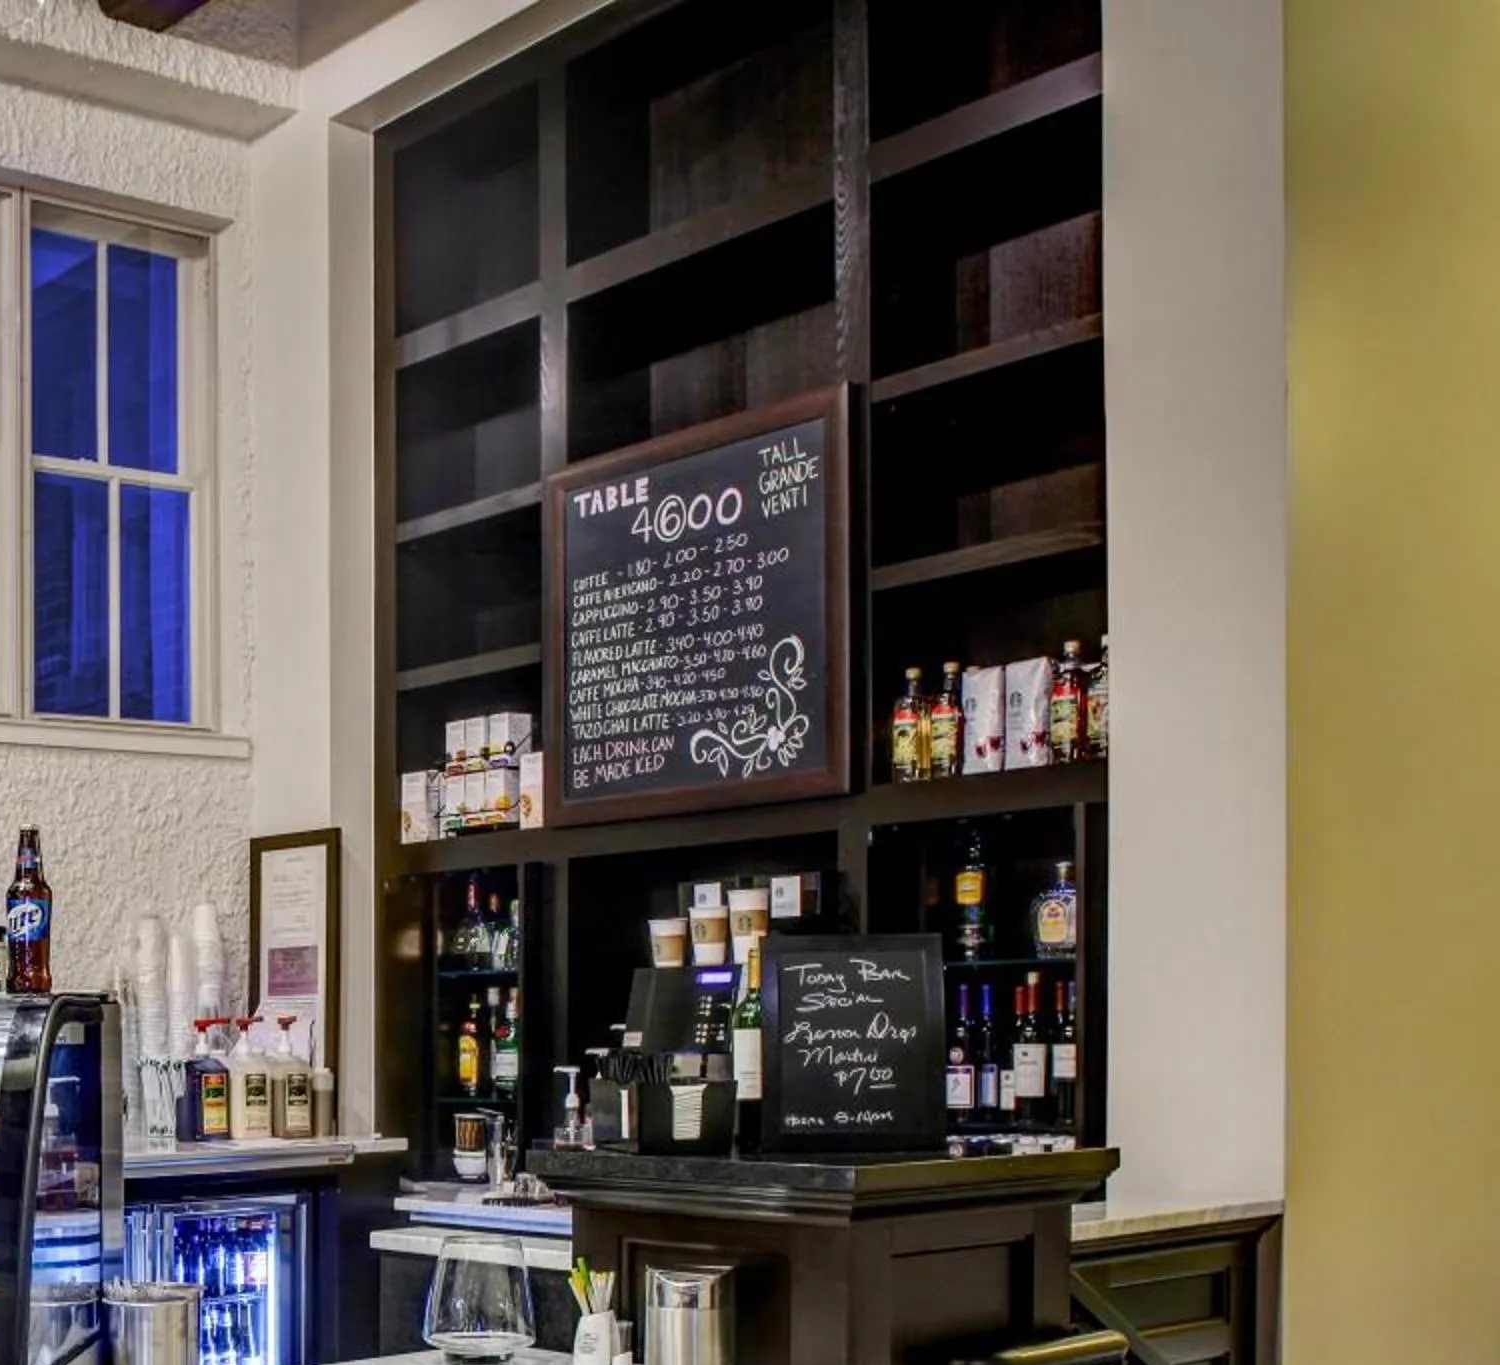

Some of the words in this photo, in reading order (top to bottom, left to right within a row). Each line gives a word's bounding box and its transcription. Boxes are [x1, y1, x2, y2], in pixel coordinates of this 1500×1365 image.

[757, 437, 807, 468] TALL
[758, 455, 820, 495] GRANDE
[573, 476, 649, 519] TABLE
[761, 484, 808, 519] VENTI
[630, 487, 743, 543] 4600
[603, 621, 636, 642] LATTE
[624, 639, 657, 659] LATTE
[633, 713, 671, 733] LATTE
[605, 737, 650, 761] DRINK
[651, 735, 675, 753] CAN
[573, 769, 590, 789] BE
[594, 759, 632, 783] MADE
[635, 753, 665, 774] ICED
